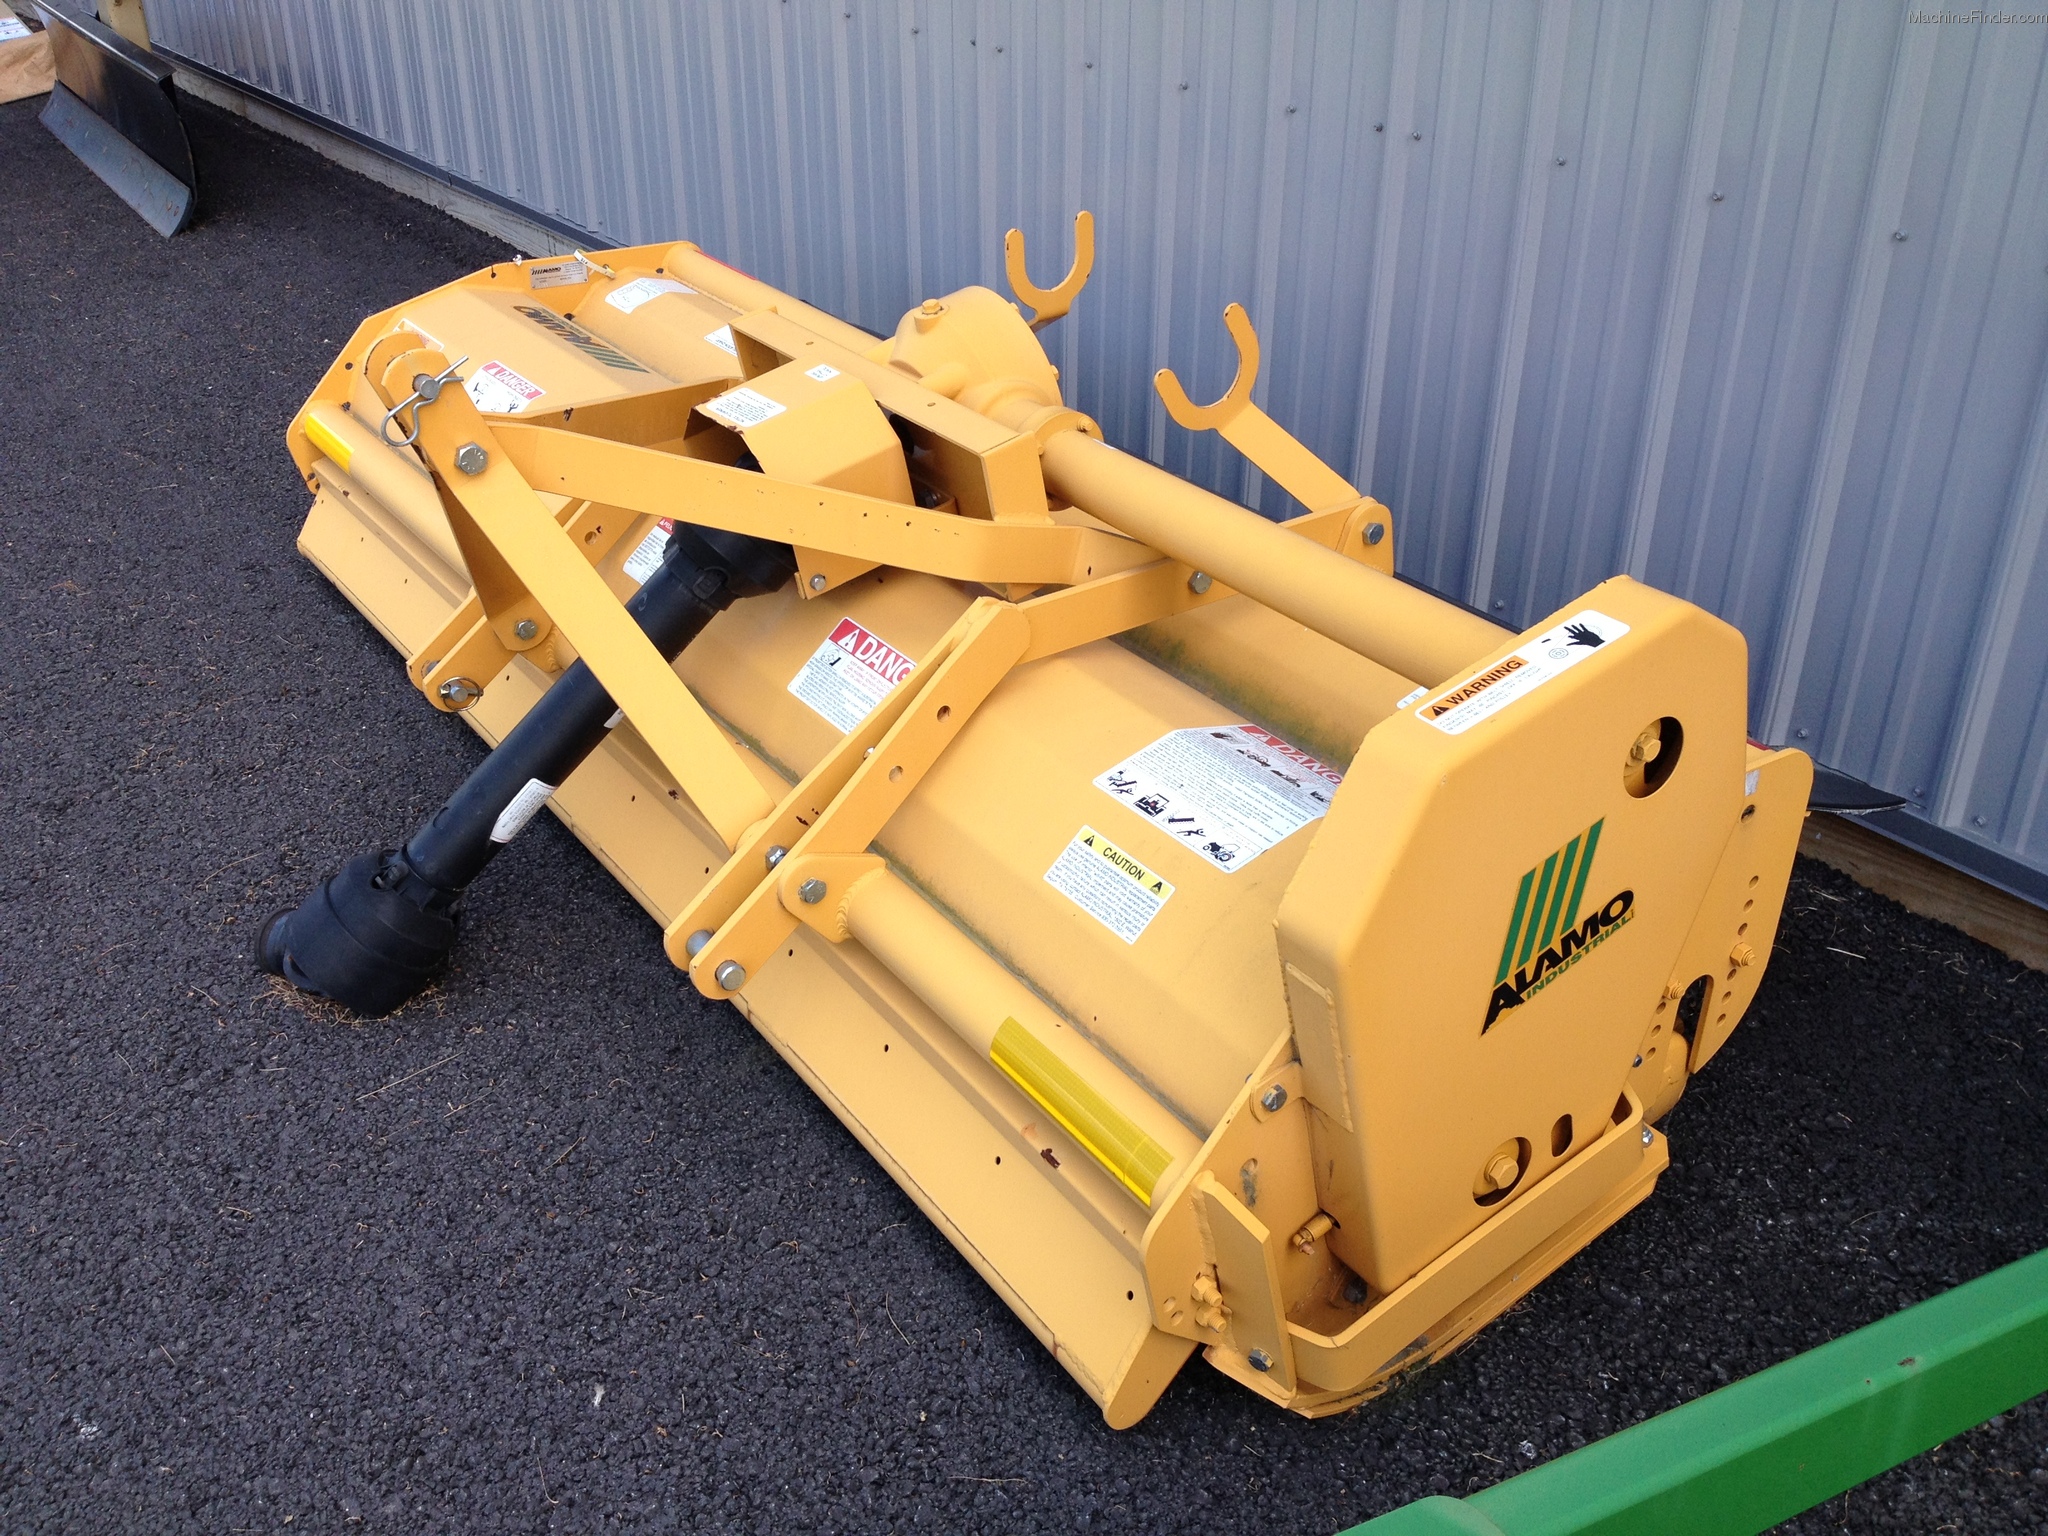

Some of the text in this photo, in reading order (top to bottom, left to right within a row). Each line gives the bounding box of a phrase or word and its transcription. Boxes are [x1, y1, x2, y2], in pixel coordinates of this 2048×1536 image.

[497, 369, 537, 397] DANGER
[854, 635, 911, 686] DANG
[1446, 660, 1523, 705] WARNING
[1271, 744, 1343, 786] DANG
[1103, 847, 1145, 880] CAUTION
[1481, 890, 1634, 1036] ALAMO
[1526, 916, 1631, 1000] INDUSTRIAL
